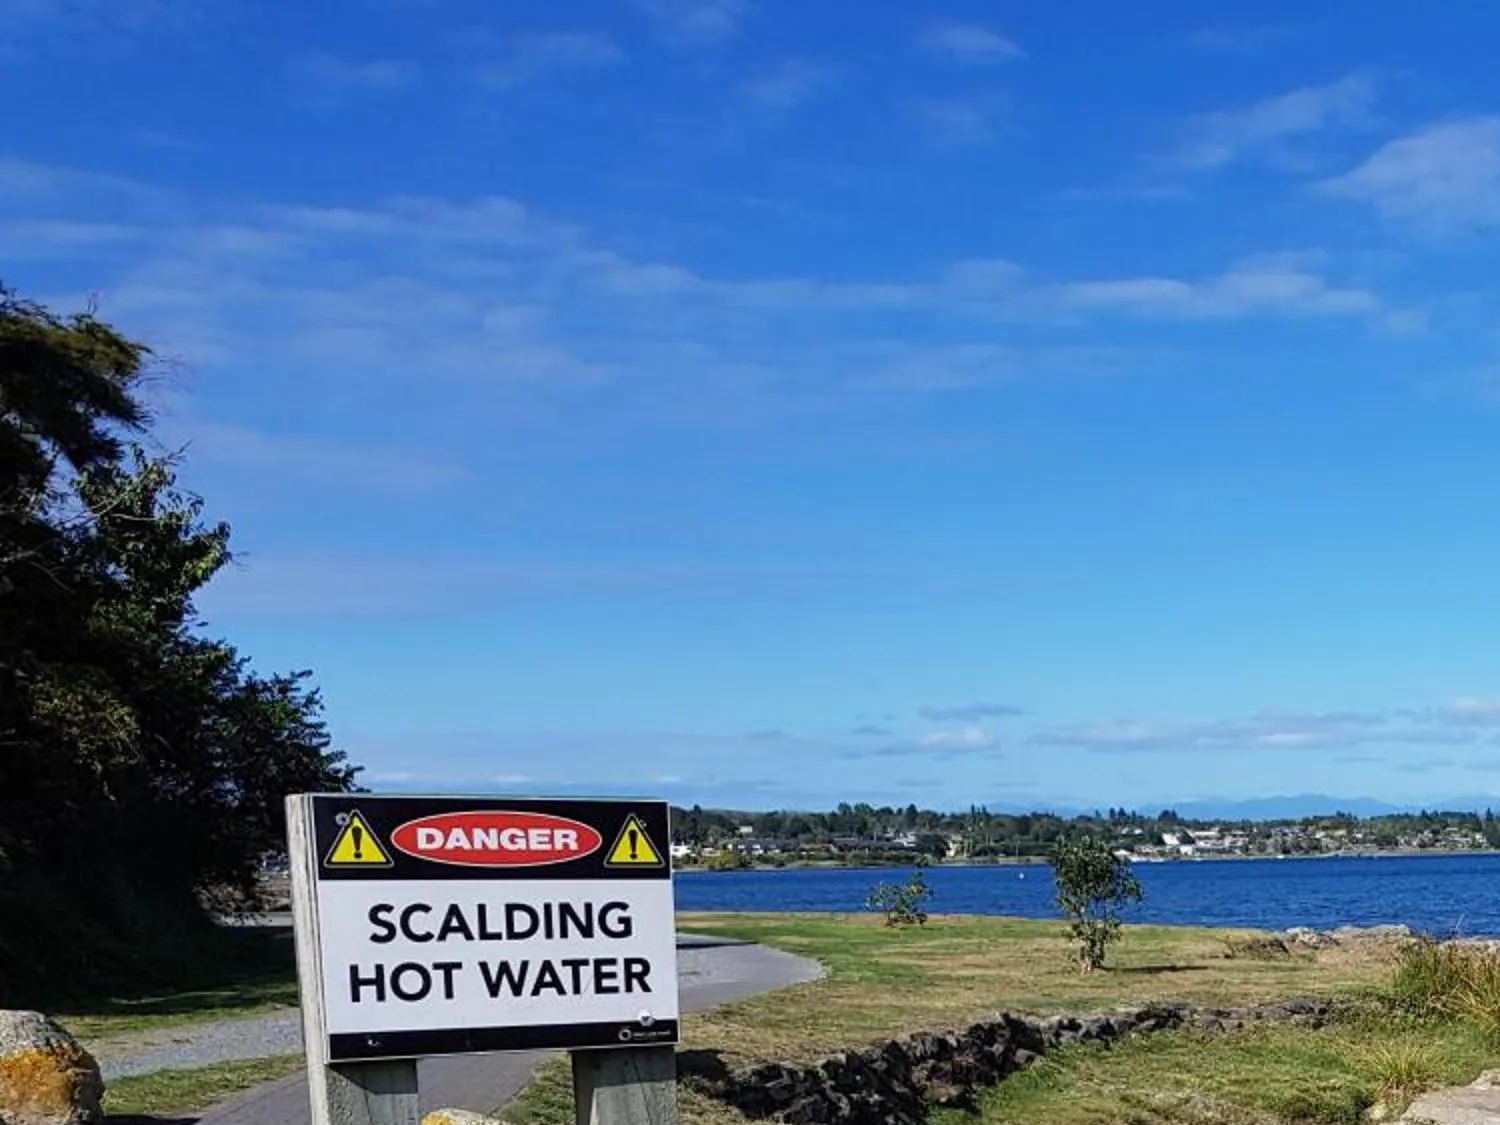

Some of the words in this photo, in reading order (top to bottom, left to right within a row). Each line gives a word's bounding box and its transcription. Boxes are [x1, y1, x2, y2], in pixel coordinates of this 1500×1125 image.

[416, 827, 578, 851] DANGER
[368, 901, 633, 943] SCALDING
[349, 962, 462, 1003] HOT
[478, 957, 652, 998] WATER
